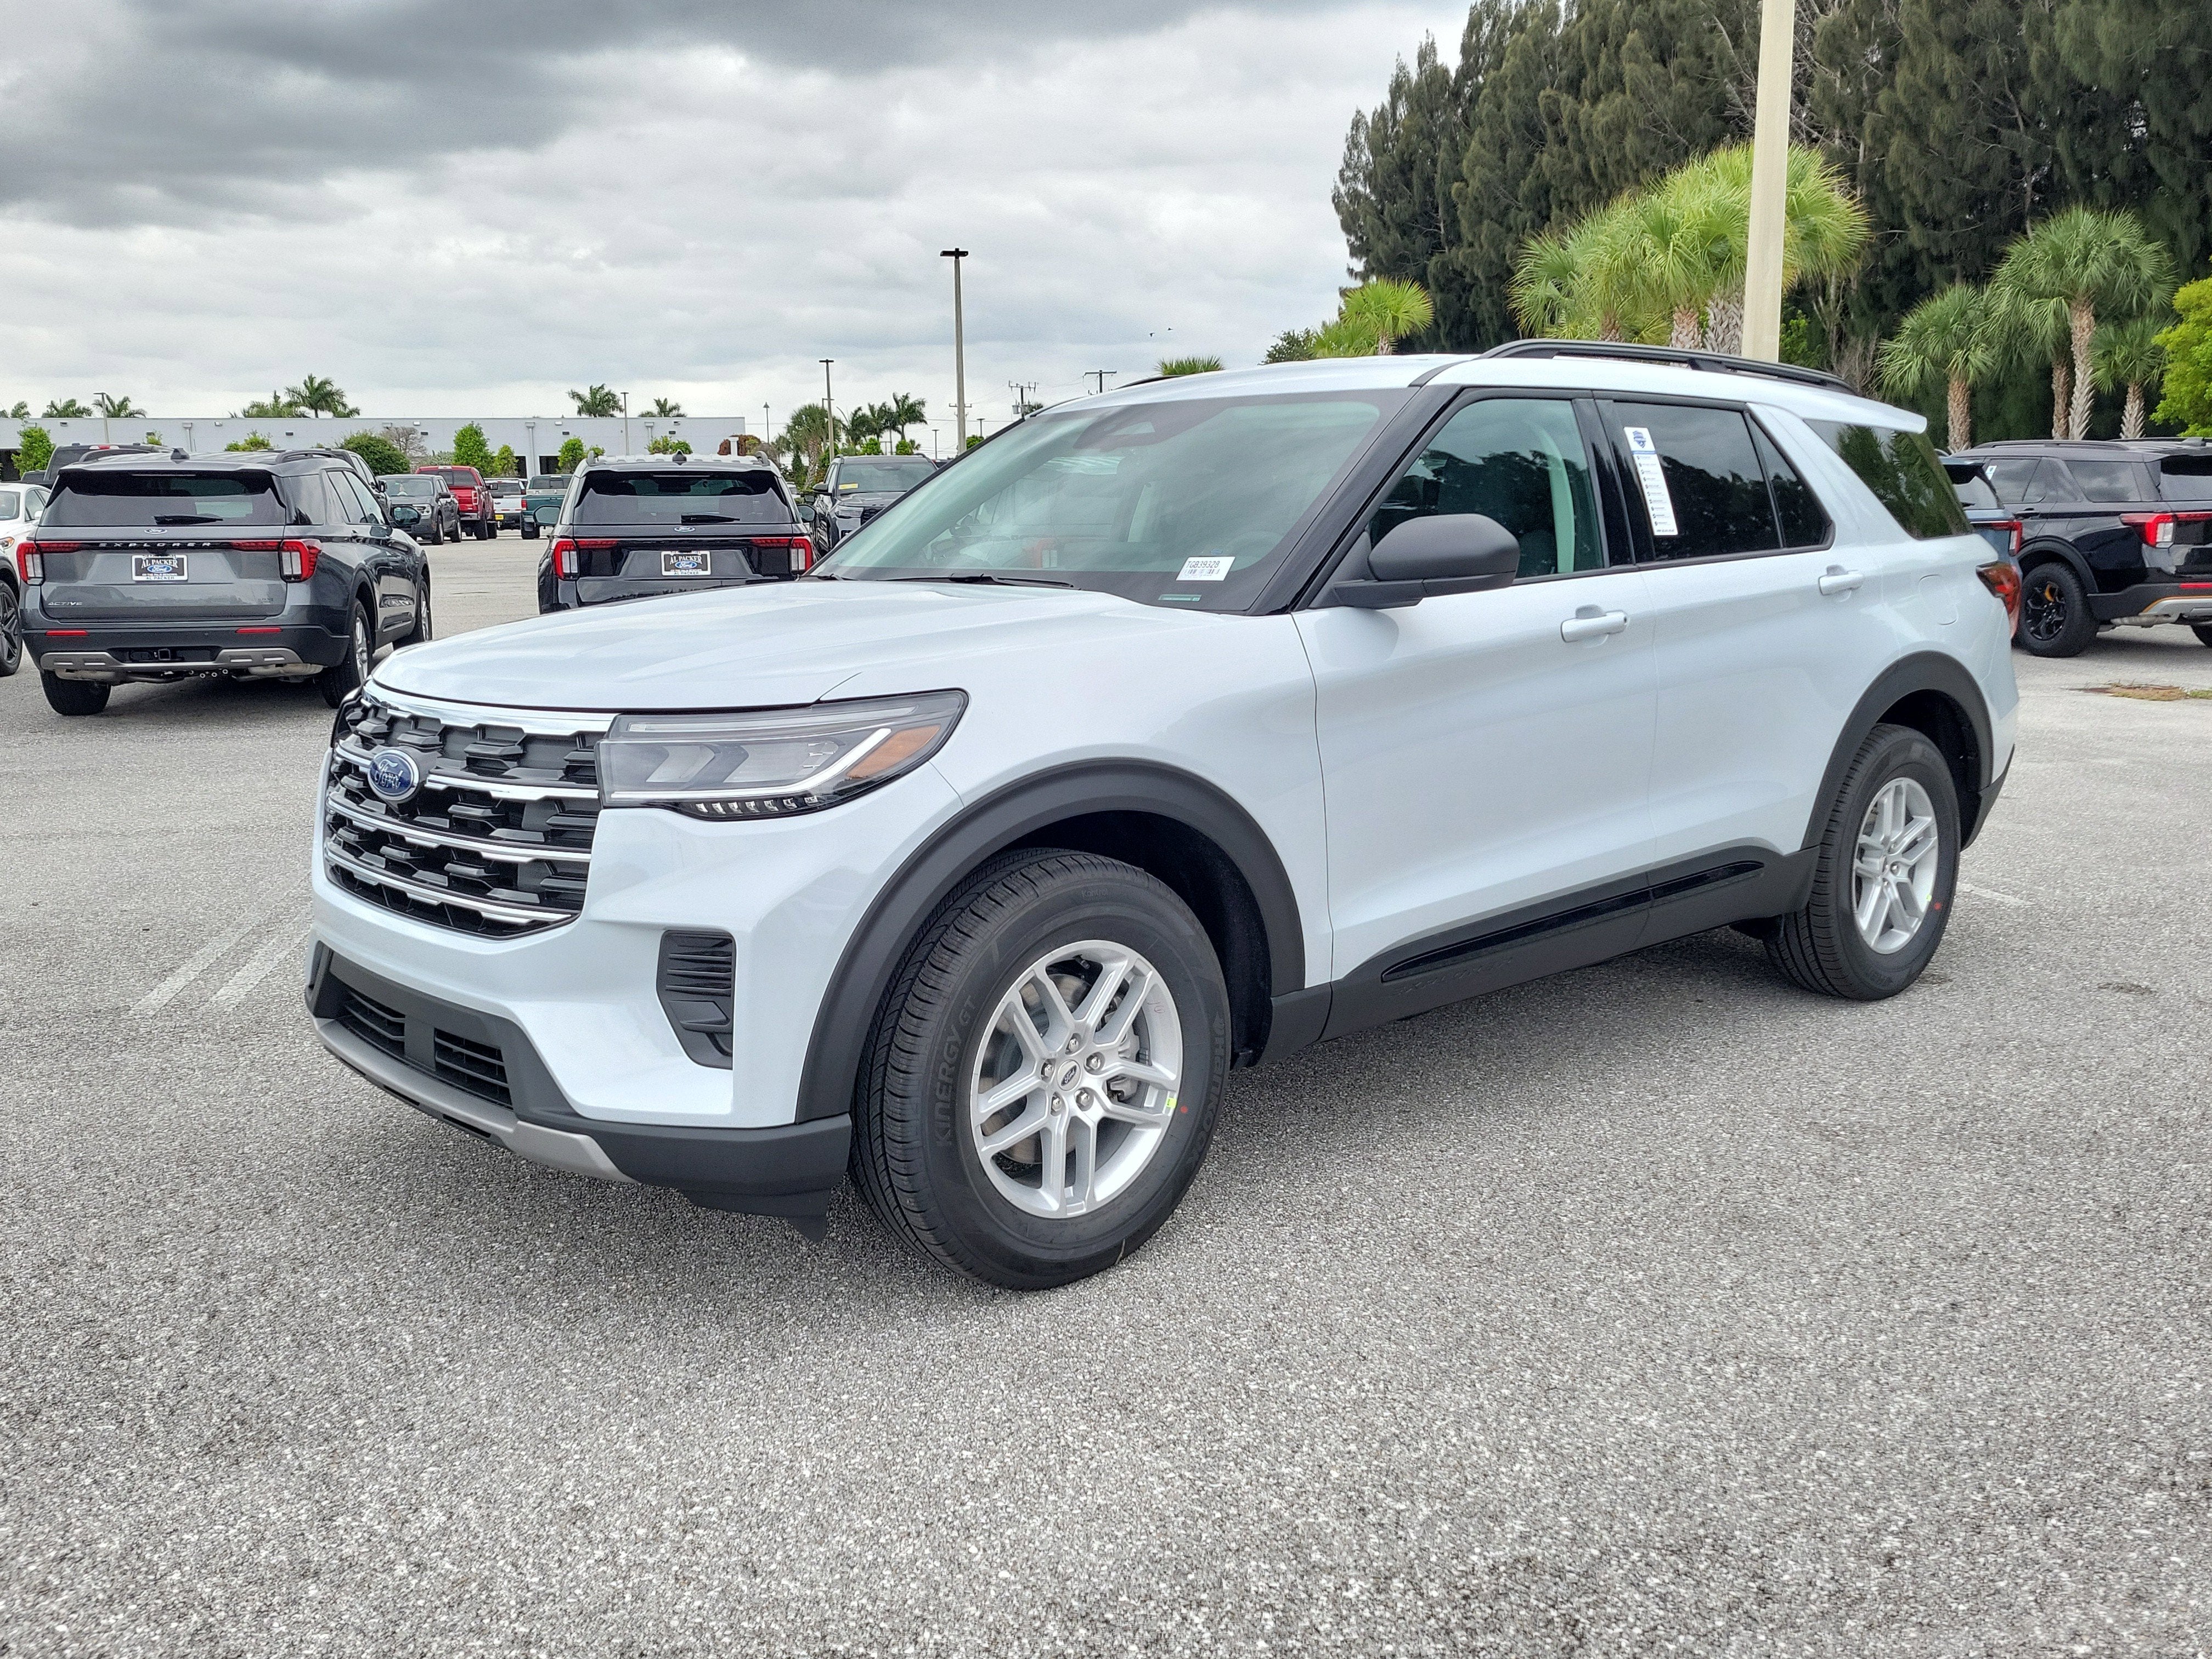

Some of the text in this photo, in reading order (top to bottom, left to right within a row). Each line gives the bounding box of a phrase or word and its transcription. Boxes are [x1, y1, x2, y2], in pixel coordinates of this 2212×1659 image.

[141, 559, 178, 568] AL PACKER
[670, 556, 703, 565] AL PACKER
[375, 759, 404, 789] Ford
[934, 995, 975, 1147] KINERGY GT
